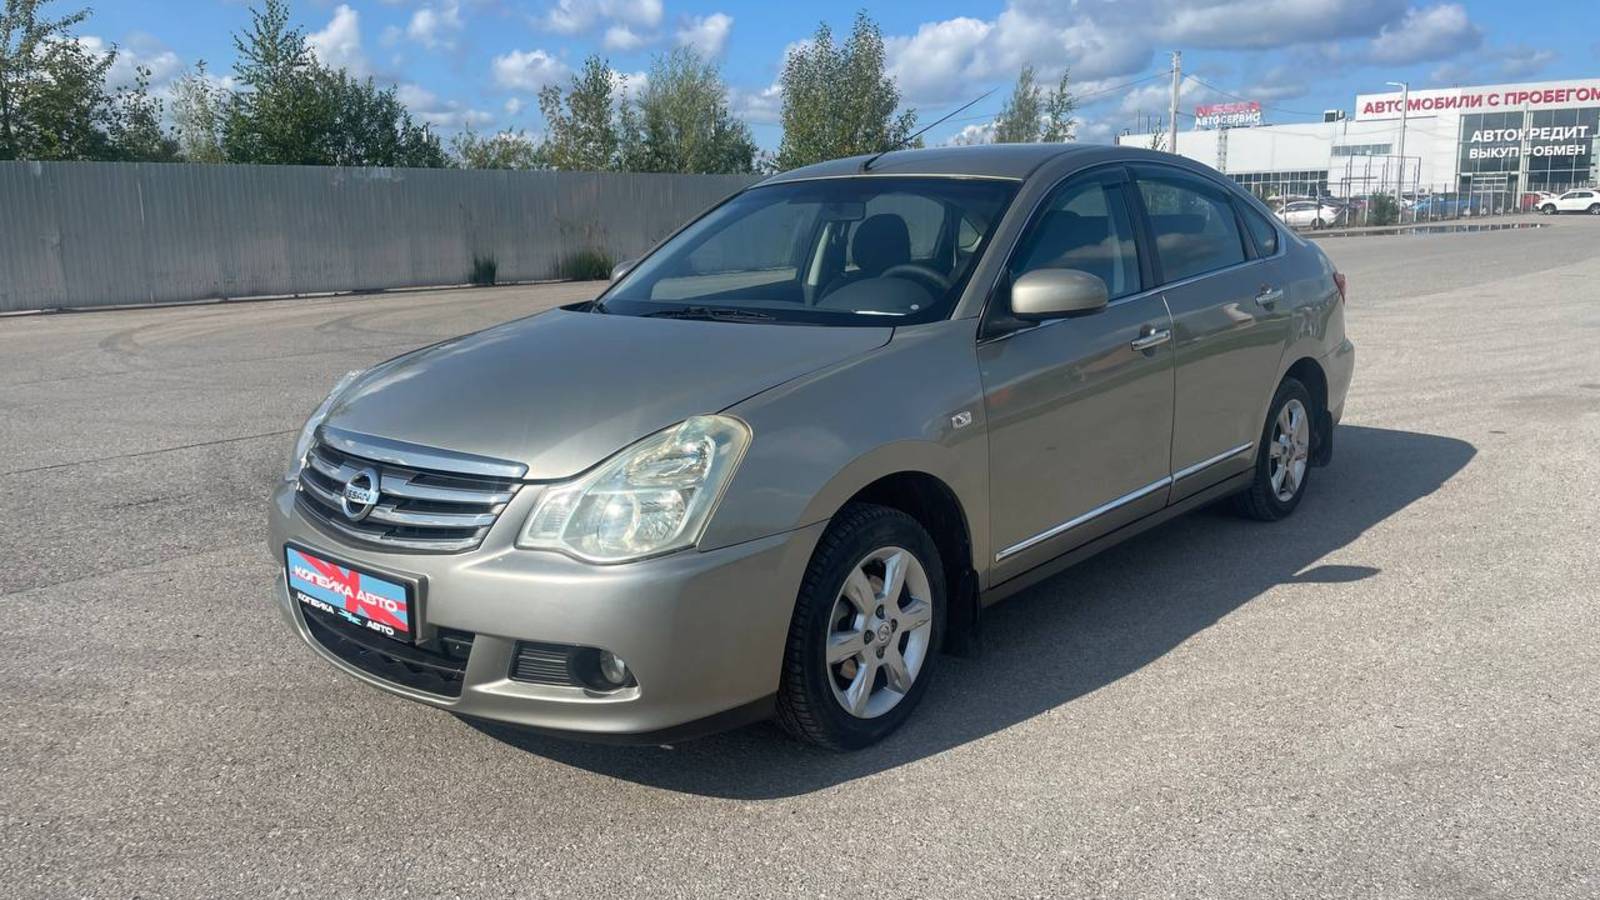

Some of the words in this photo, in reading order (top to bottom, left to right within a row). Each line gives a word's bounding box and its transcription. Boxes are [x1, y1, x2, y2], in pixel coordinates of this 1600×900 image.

[1363, 94, 1483, 114] АВТОМОБИЛИ
[1487, 93, 1500, 106] С
[1504, 87, 1600, 105] ПРОБЕГОМ
[1471, 126, 1588, 142] АВТОКРЕДИТ
[1469, 146, 1519, 159] ВЫКУП
[1533, 144, 1586, 157] ОБМЕН
[294, 566, 354, 598] КОПЕЙКА
[356, 590, 397, 612] АВТО
[366, 620, 395, 635] АВТО
